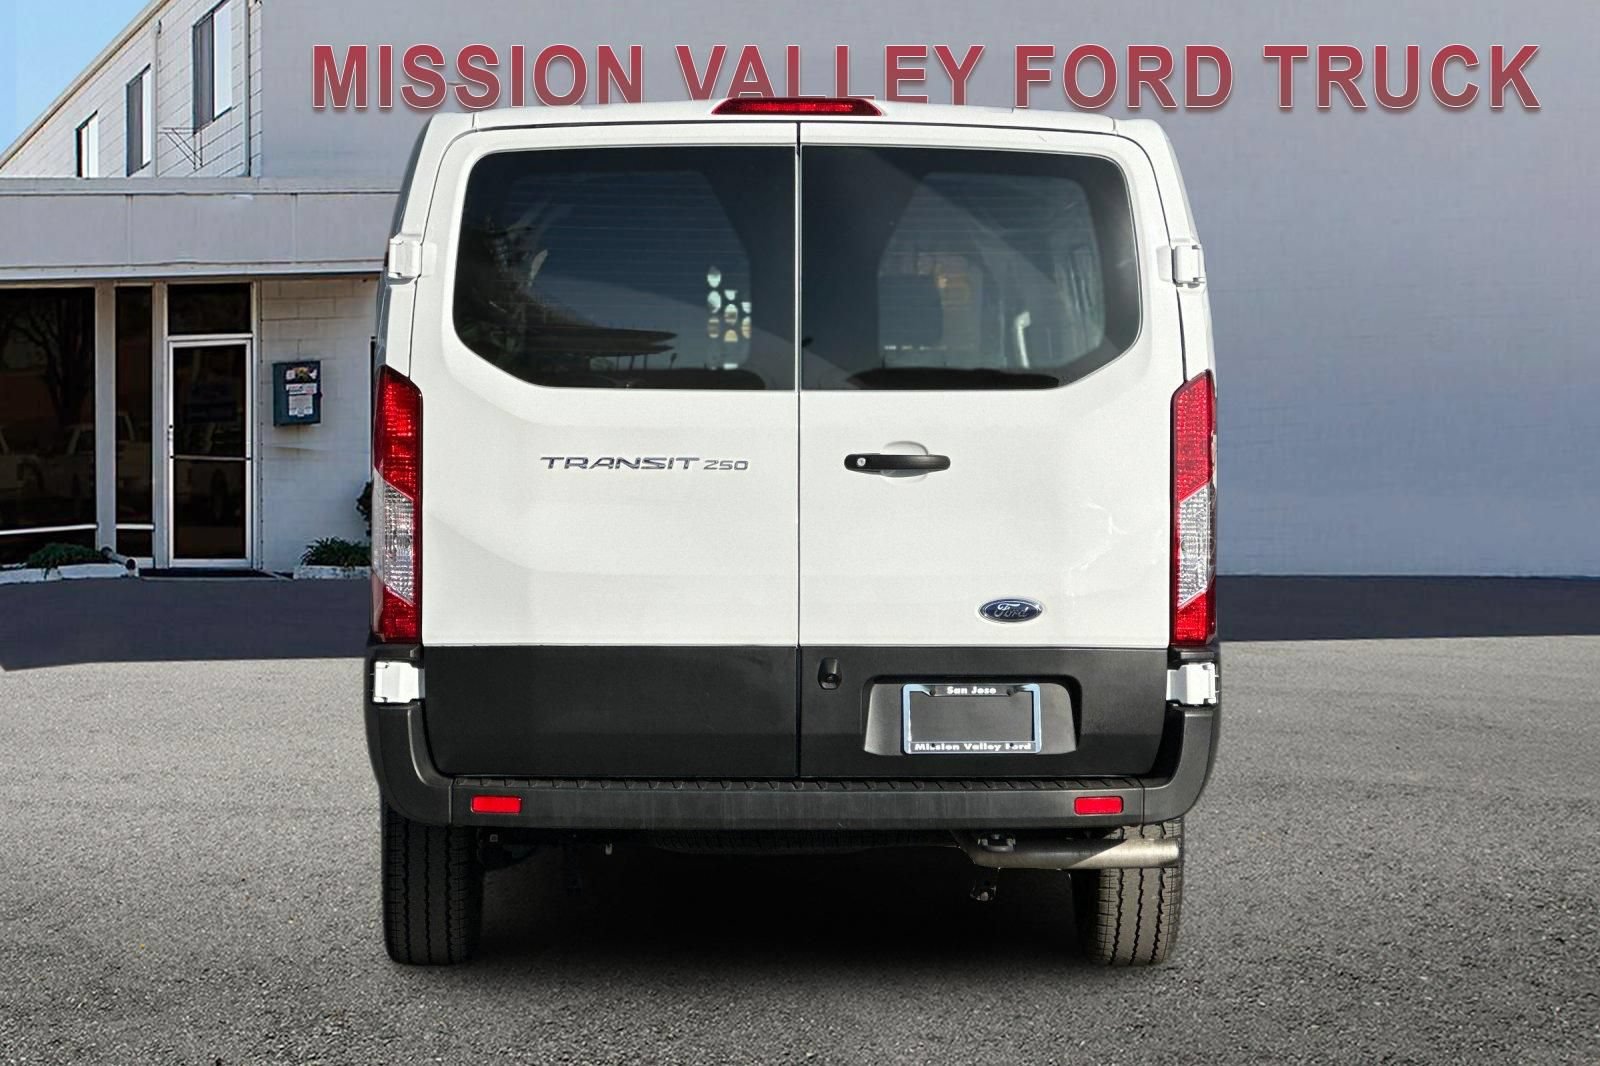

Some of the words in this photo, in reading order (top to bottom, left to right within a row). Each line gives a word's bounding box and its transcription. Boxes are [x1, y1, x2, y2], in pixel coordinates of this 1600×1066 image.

[311, 43, 643, 109] MISSION
[676, 44, 986, 104] VALLEY
[1014, 43, 1234, 110] FORD
[1263, 43, 1542, 110] TRUCK
[540, 456, 700, 470] TRANSIT
[703, 459, 749, 471] 250
[994, 603, 1031, 618] Ford
[946, 686, 968, 695] San
[971, 686, 997, 695] Jose
[964, 743, 1001, 752] Valley
